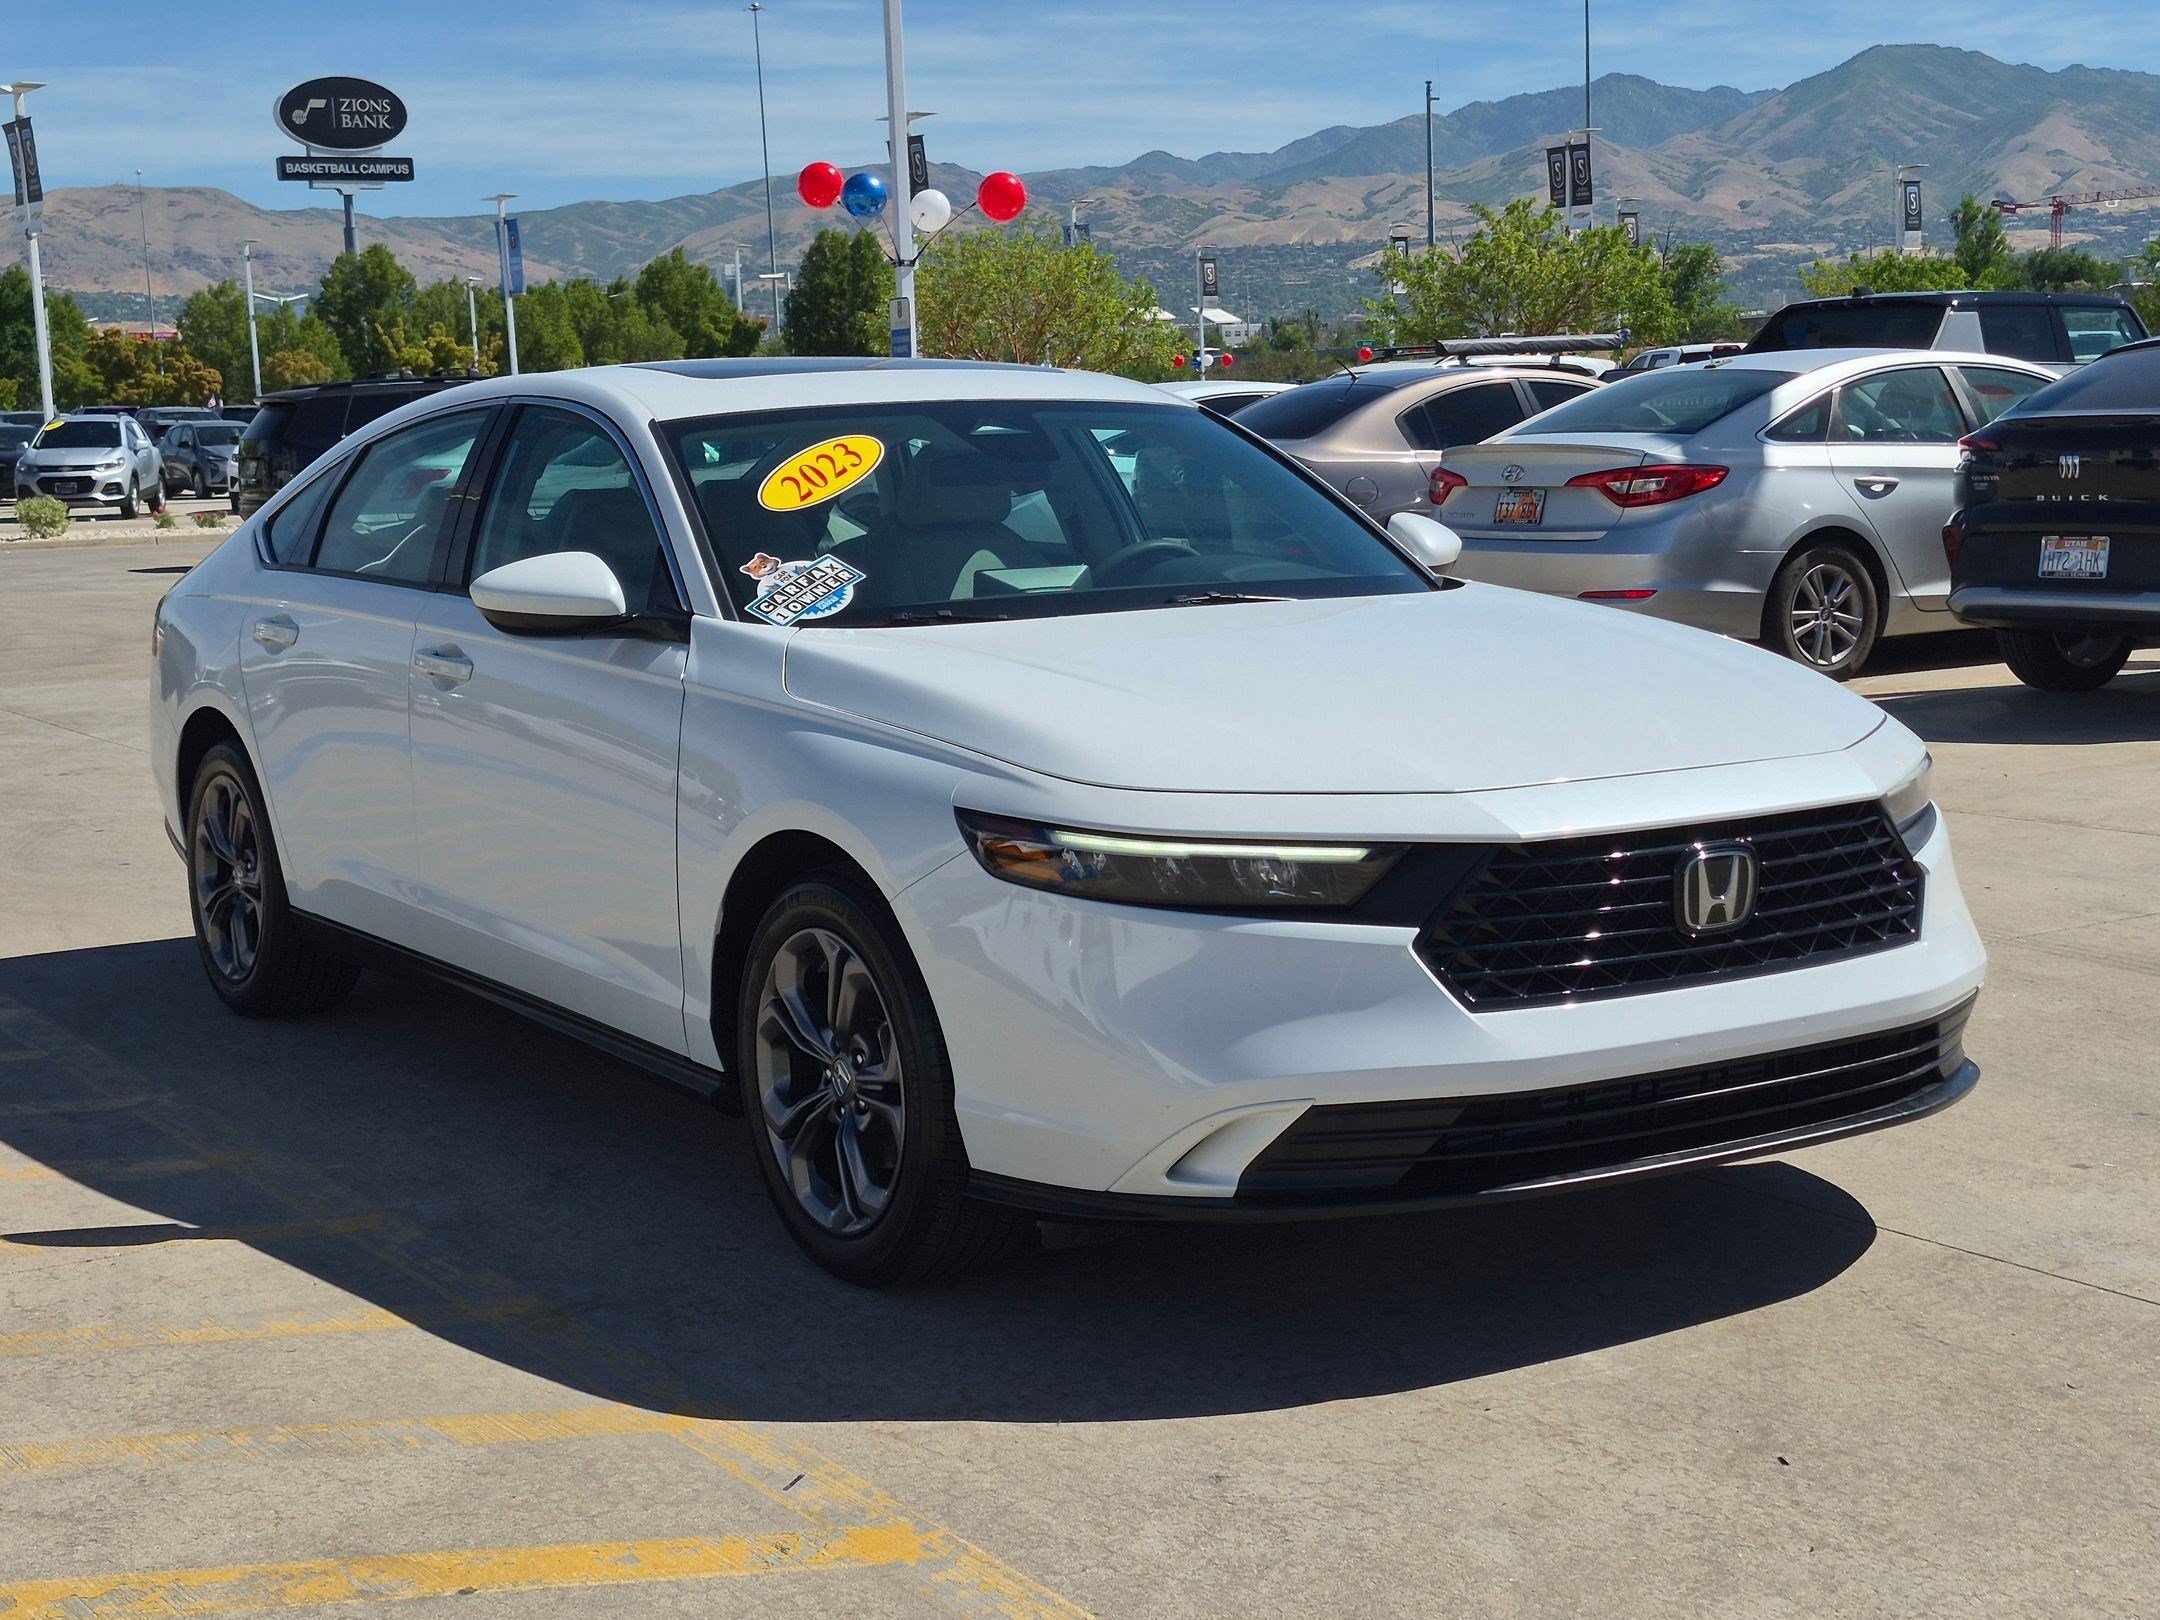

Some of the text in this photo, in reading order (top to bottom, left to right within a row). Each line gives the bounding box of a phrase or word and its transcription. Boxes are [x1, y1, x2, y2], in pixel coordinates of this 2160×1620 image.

[339, 98, 391, 113] ZIONS
[341, 114, 392, 129] BANK
[285, 163, 409, 175] BASKETBALL CAMPUS
[1578, 159, 1585, 179] S
[1909, 193, 1916, 209] S
[780, 443, 862, 502] 2023
[2047, 551, 2101, 571] H72 1HK
[773, 570, 788, 581] CAR
[780, 574, 795, 584] FOX
[760, 563, 838, 612] CARFAX
[776, 612, 789, 621] 1
[787, 570, 854, 613] OWNER
